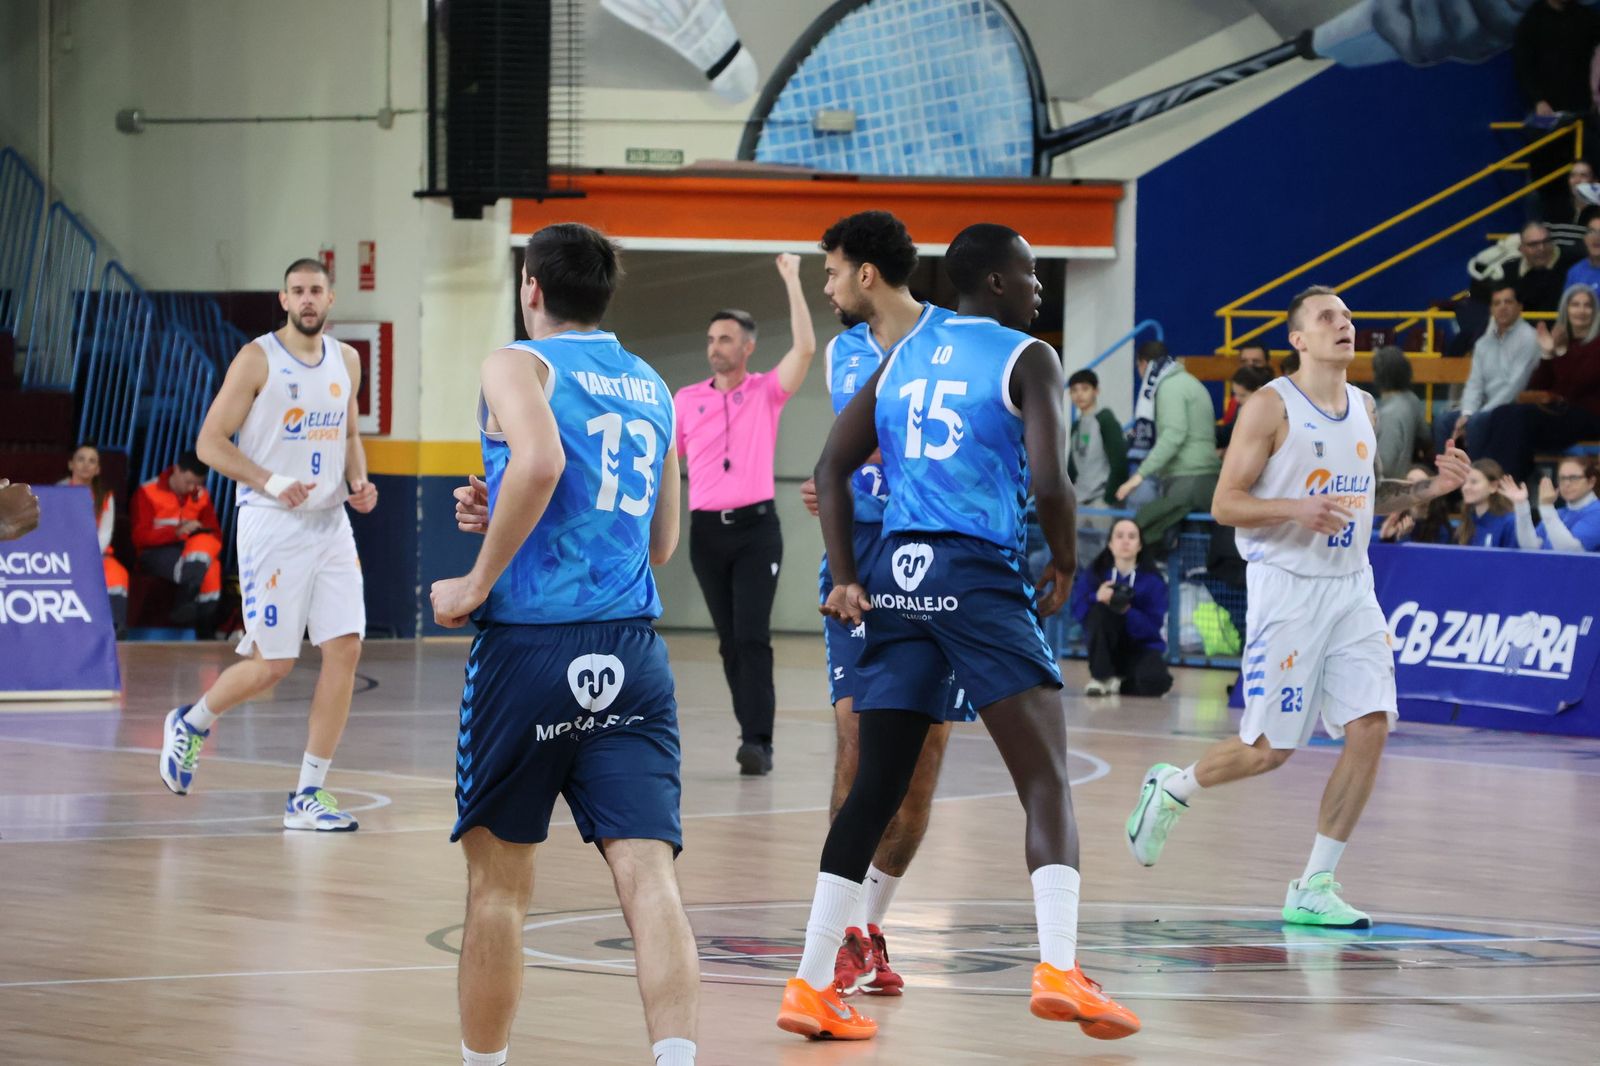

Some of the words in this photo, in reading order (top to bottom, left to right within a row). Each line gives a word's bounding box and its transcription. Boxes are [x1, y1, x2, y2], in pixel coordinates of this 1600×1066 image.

[931, 345, 953, 365] LO
[899, 378, 967, 461] 15
[311, 452, 321, 475] 9
[586, 412, 657, 517] 13
[871, 593, 958, 611] MORALEJO
[264, 604, 278, 628] 9
[1281, 687, 1303, 713] 23
